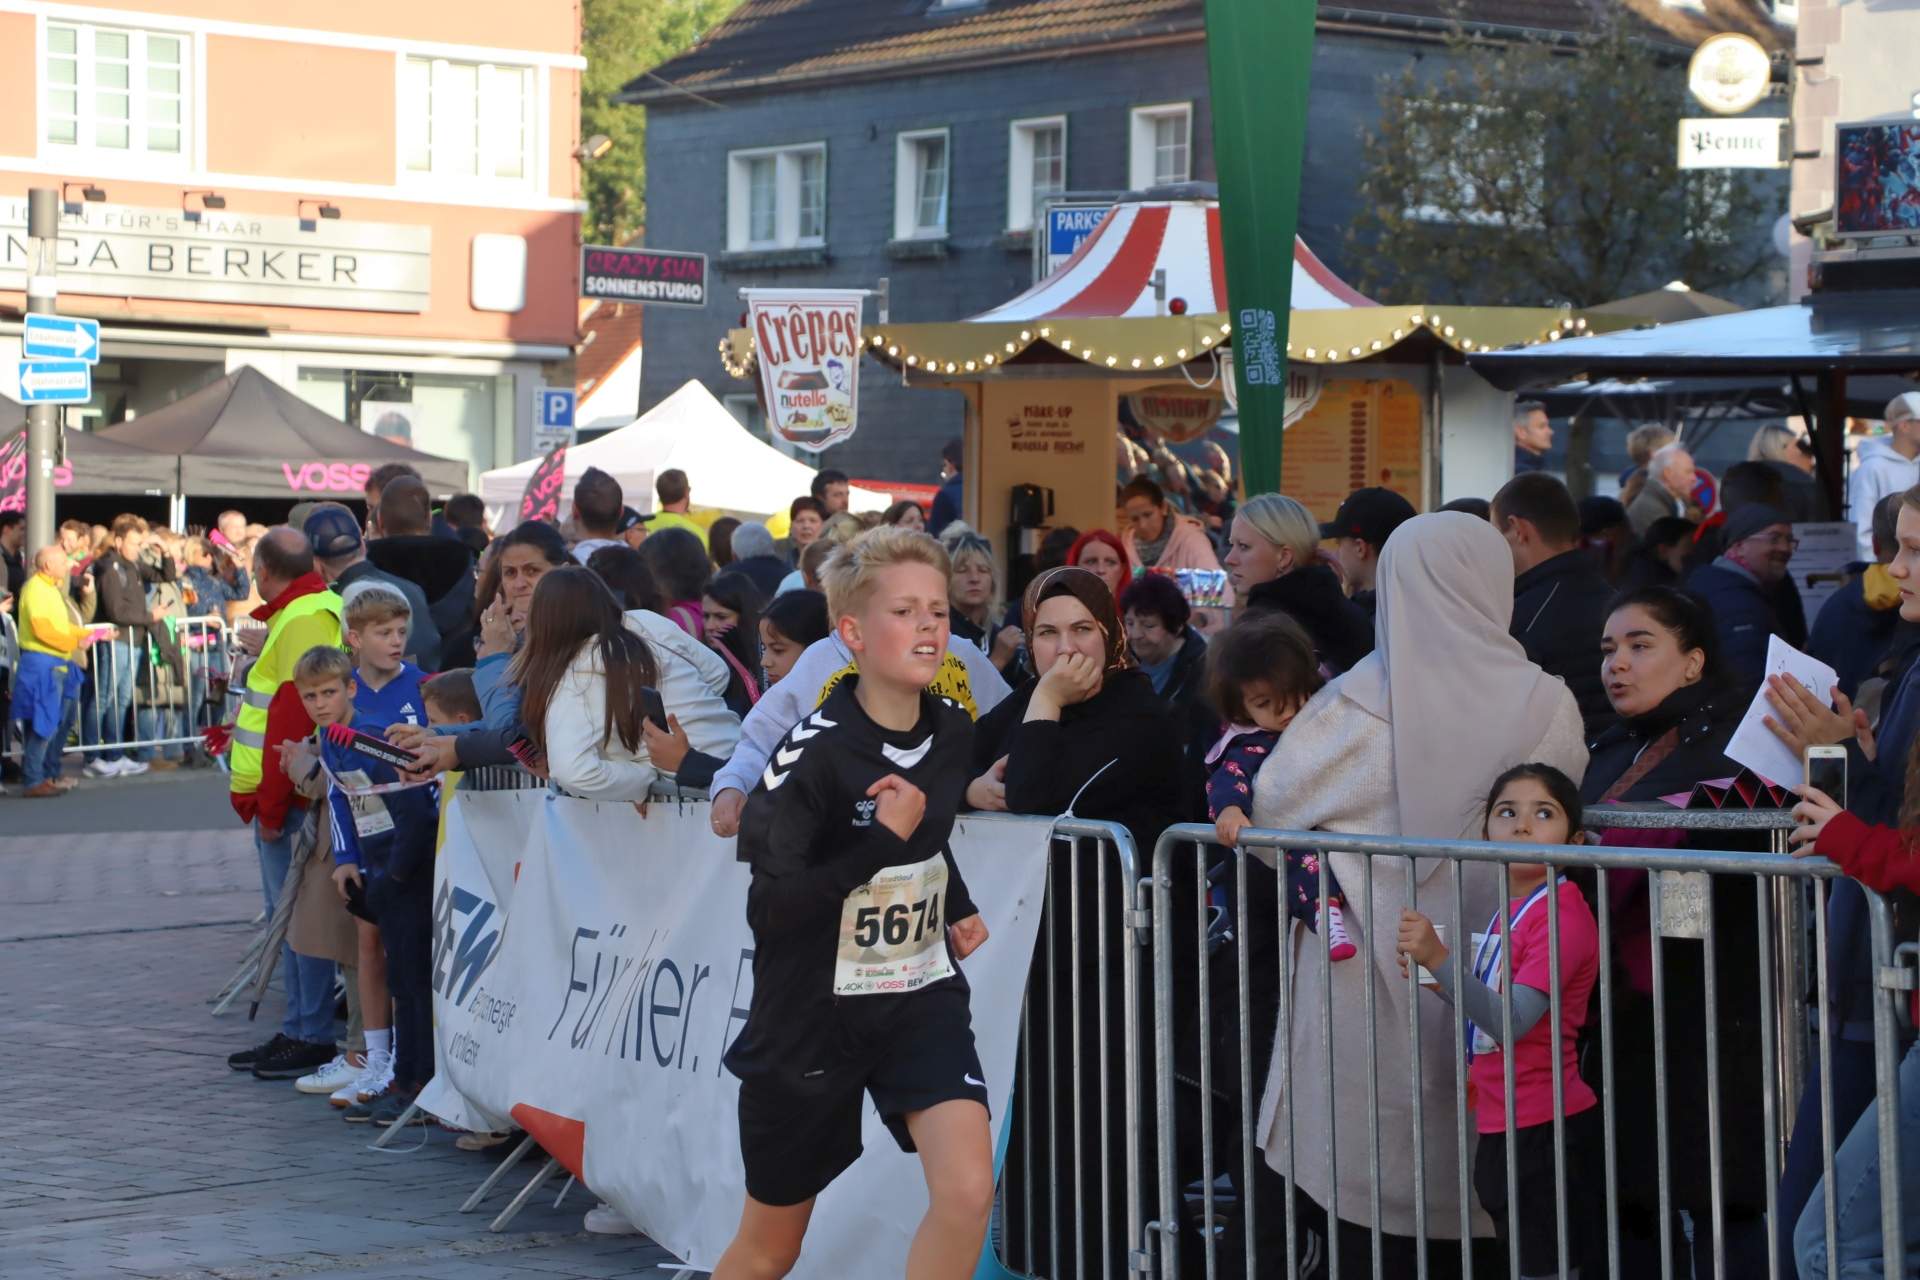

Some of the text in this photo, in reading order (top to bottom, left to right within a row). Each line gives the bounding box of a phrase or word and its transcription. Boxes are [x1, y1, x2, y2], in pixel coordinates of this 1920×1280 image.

[1691, 131, 1766, 154] Penne
[195, 216, 263, 236] HAAR
[147, 243, 358, 284] BERKER
[587, 251, 702, 279] CRAZY SUN
[586, 276, 703, 302] SONNENSTUDIO
[757, 303, 856, 366] Crêpes
[781, 389, 827, 408] nutella
[282, 463, 372, 492] VOSS
[854, 892, 939, 947] 5674
[843, 981, 864, 991] AOK
[875, 980, 906, 989] VOSS
[906, 976, 924, 988] BEW
